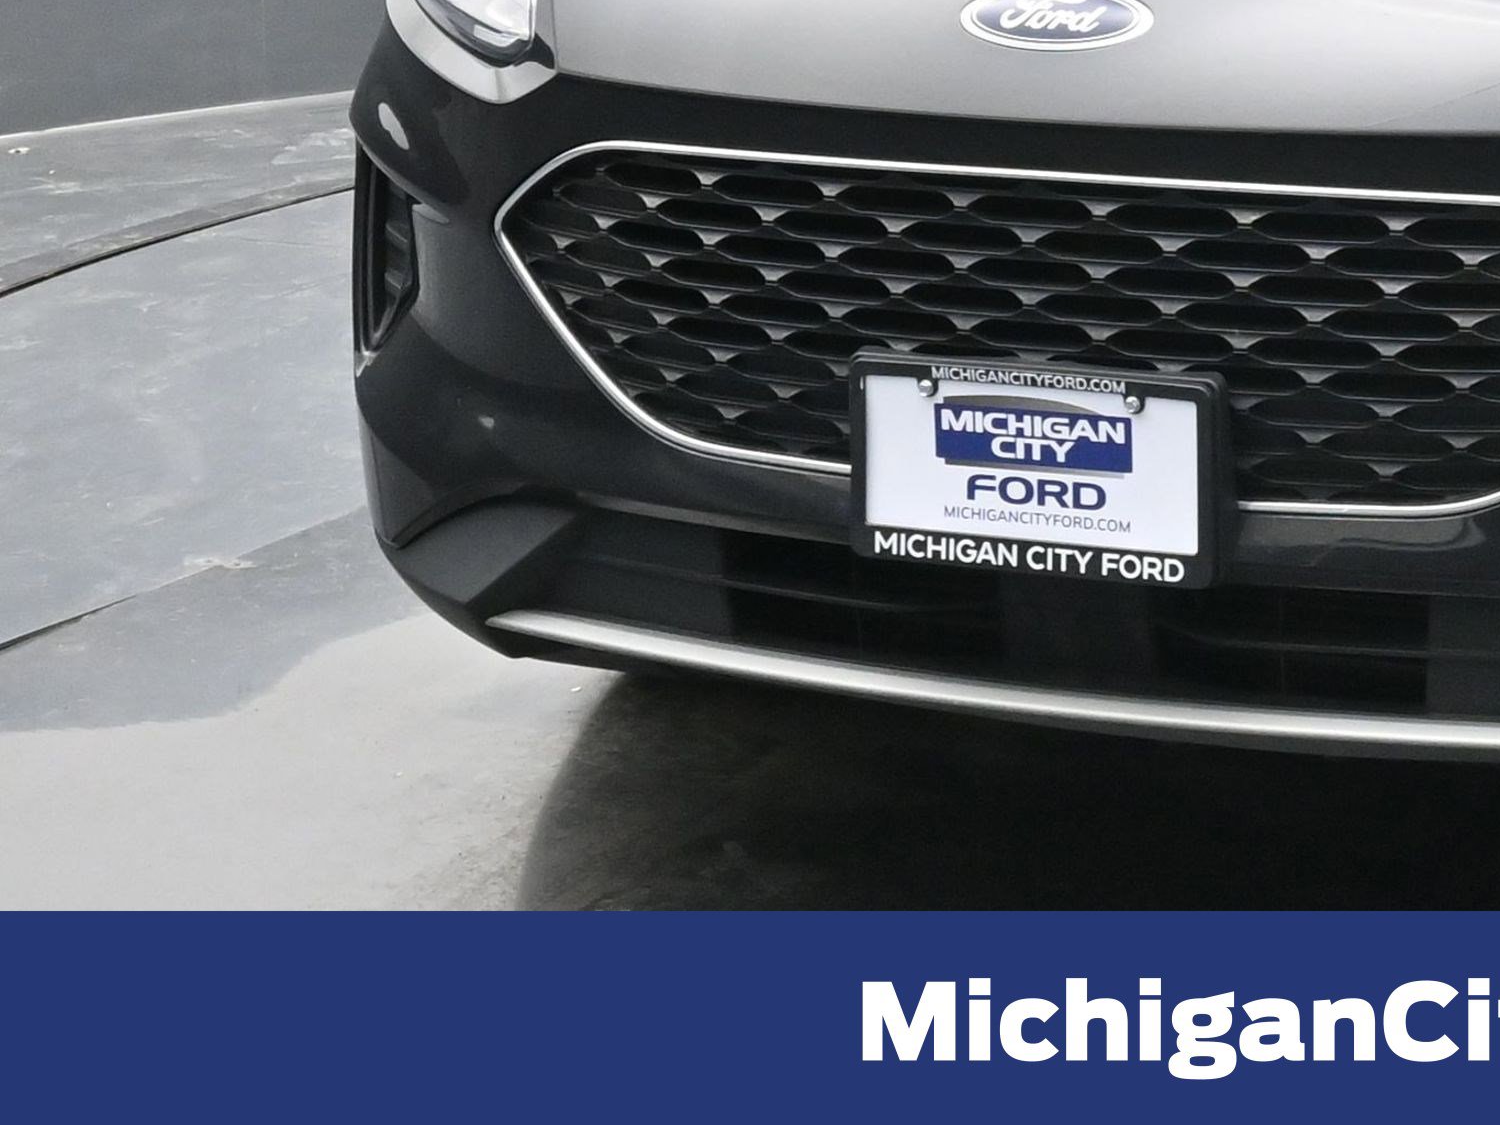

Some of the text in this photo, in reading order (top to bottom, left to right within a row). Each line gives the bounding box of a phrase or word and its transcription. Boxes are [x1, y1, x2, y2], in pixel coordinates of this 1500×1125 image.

[931, 365, 1126, 394] MICHIGANCITYFORD.COM
[940, 408, 1126, 445] MICHIGAN
[990, 437, 1077, 463] CITY
[966, 474, 1107, 510] FORD
[944, 505, 1132, 534] MICHIGANCITYFORD.COM
[873, 531, 1186, 583] MICHIGAN CITY FORD
